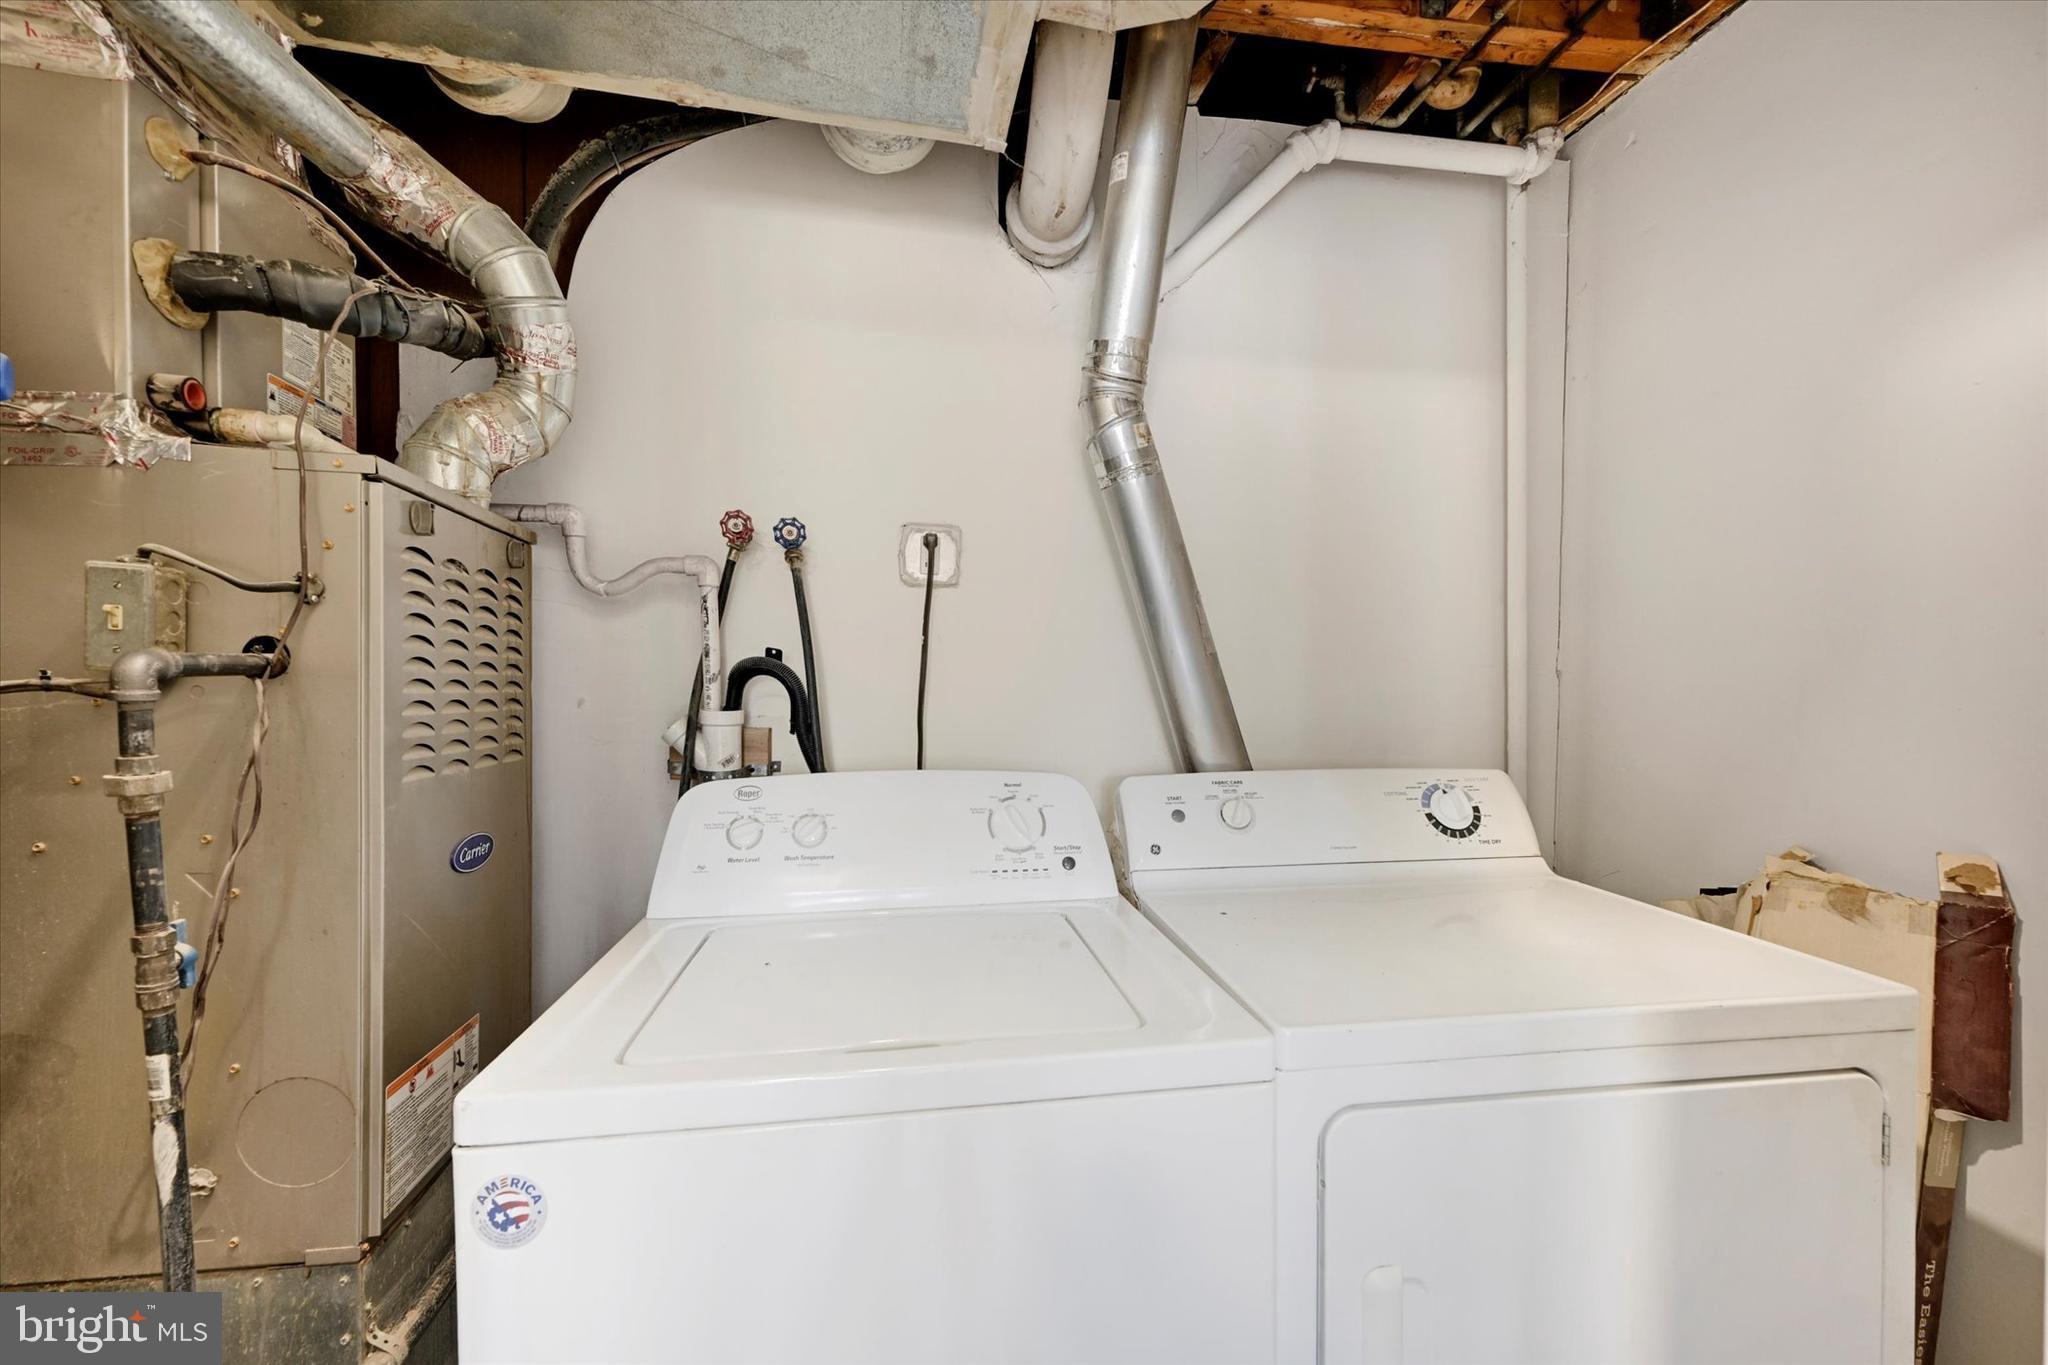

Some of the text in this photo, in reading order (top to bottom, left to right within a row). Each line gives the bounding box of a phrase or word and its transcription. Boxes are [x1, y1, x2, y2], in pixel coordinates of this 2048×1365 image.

[737, 789, 760, 799] Roper
[459, 842, 490, 863] Carrier
[800, 854, 834, 862] Temperature
[477, 1176, 542, 1205] AMERICA
[1922, 1260, 1935, 1297] The
